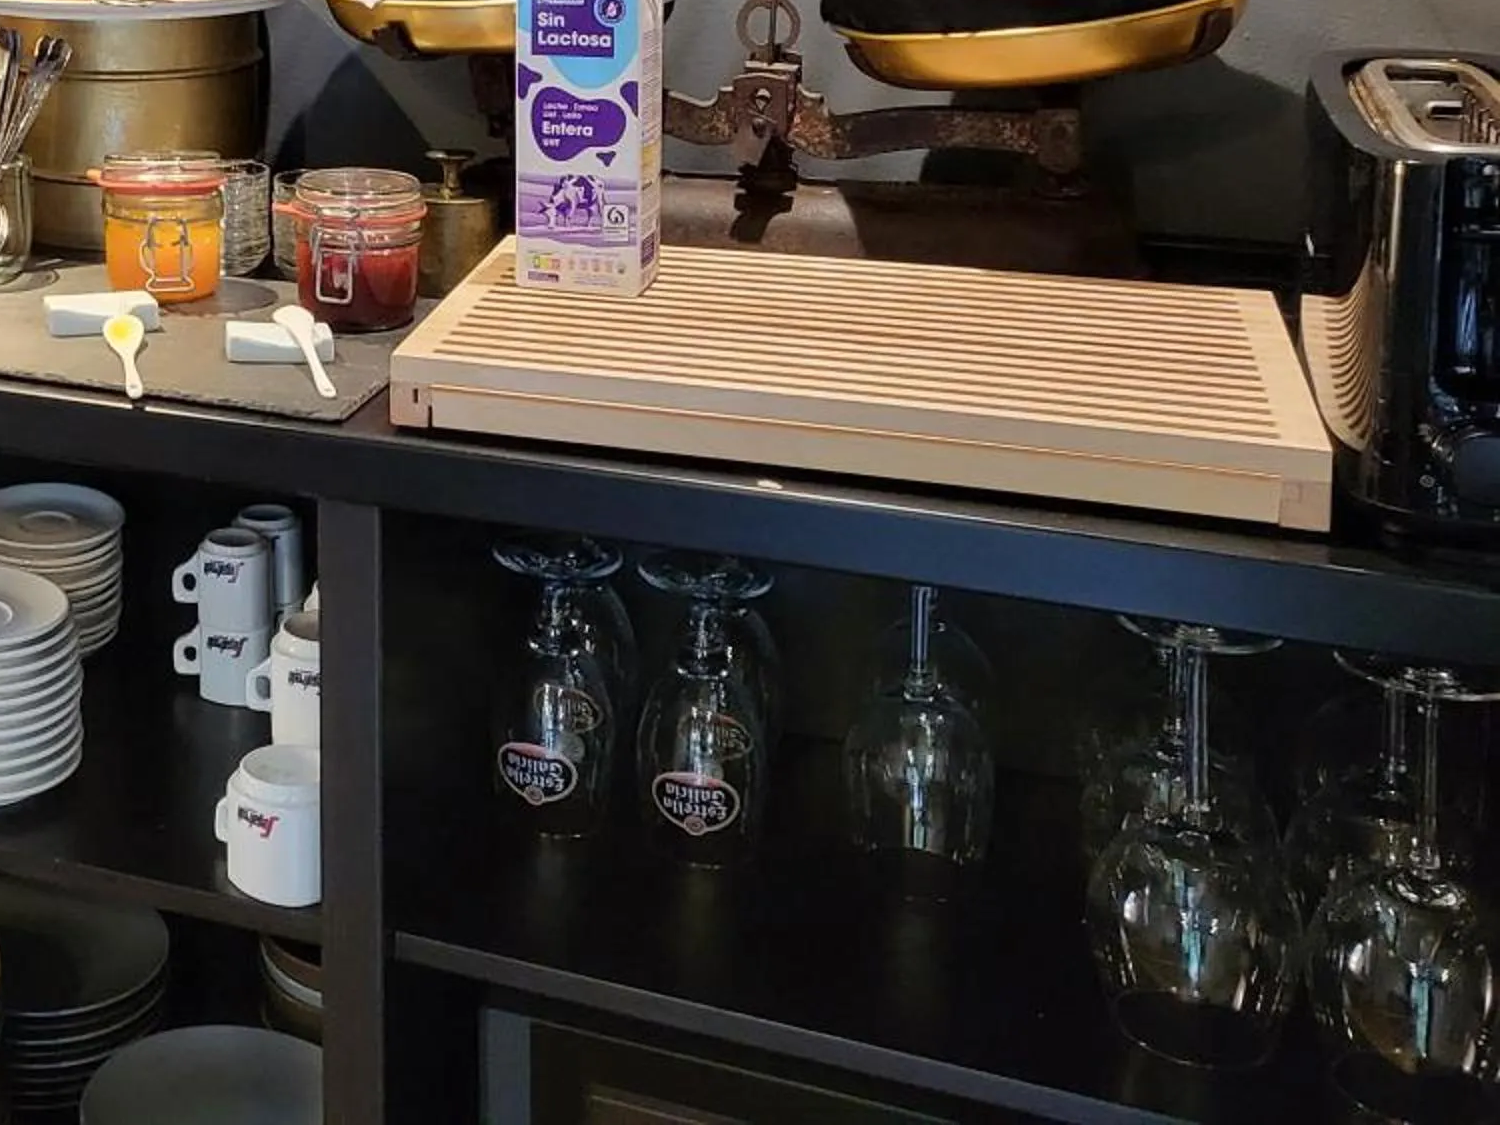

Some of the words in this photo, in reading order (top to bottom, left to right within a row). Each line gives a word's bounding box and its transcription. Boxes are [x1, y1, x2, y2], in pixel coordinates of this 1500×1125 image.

[537, 11, 565, 28] Sin
[537, 30, 611, 48] Lactosa
[542, 120, 593, 137] Entera
[507, 751, 563, 777] Galicia
[505, 764, 565, 792] Estrella
[665, 781, 725, 806] Galicia
[663, 795, 728, 820] Estrella
